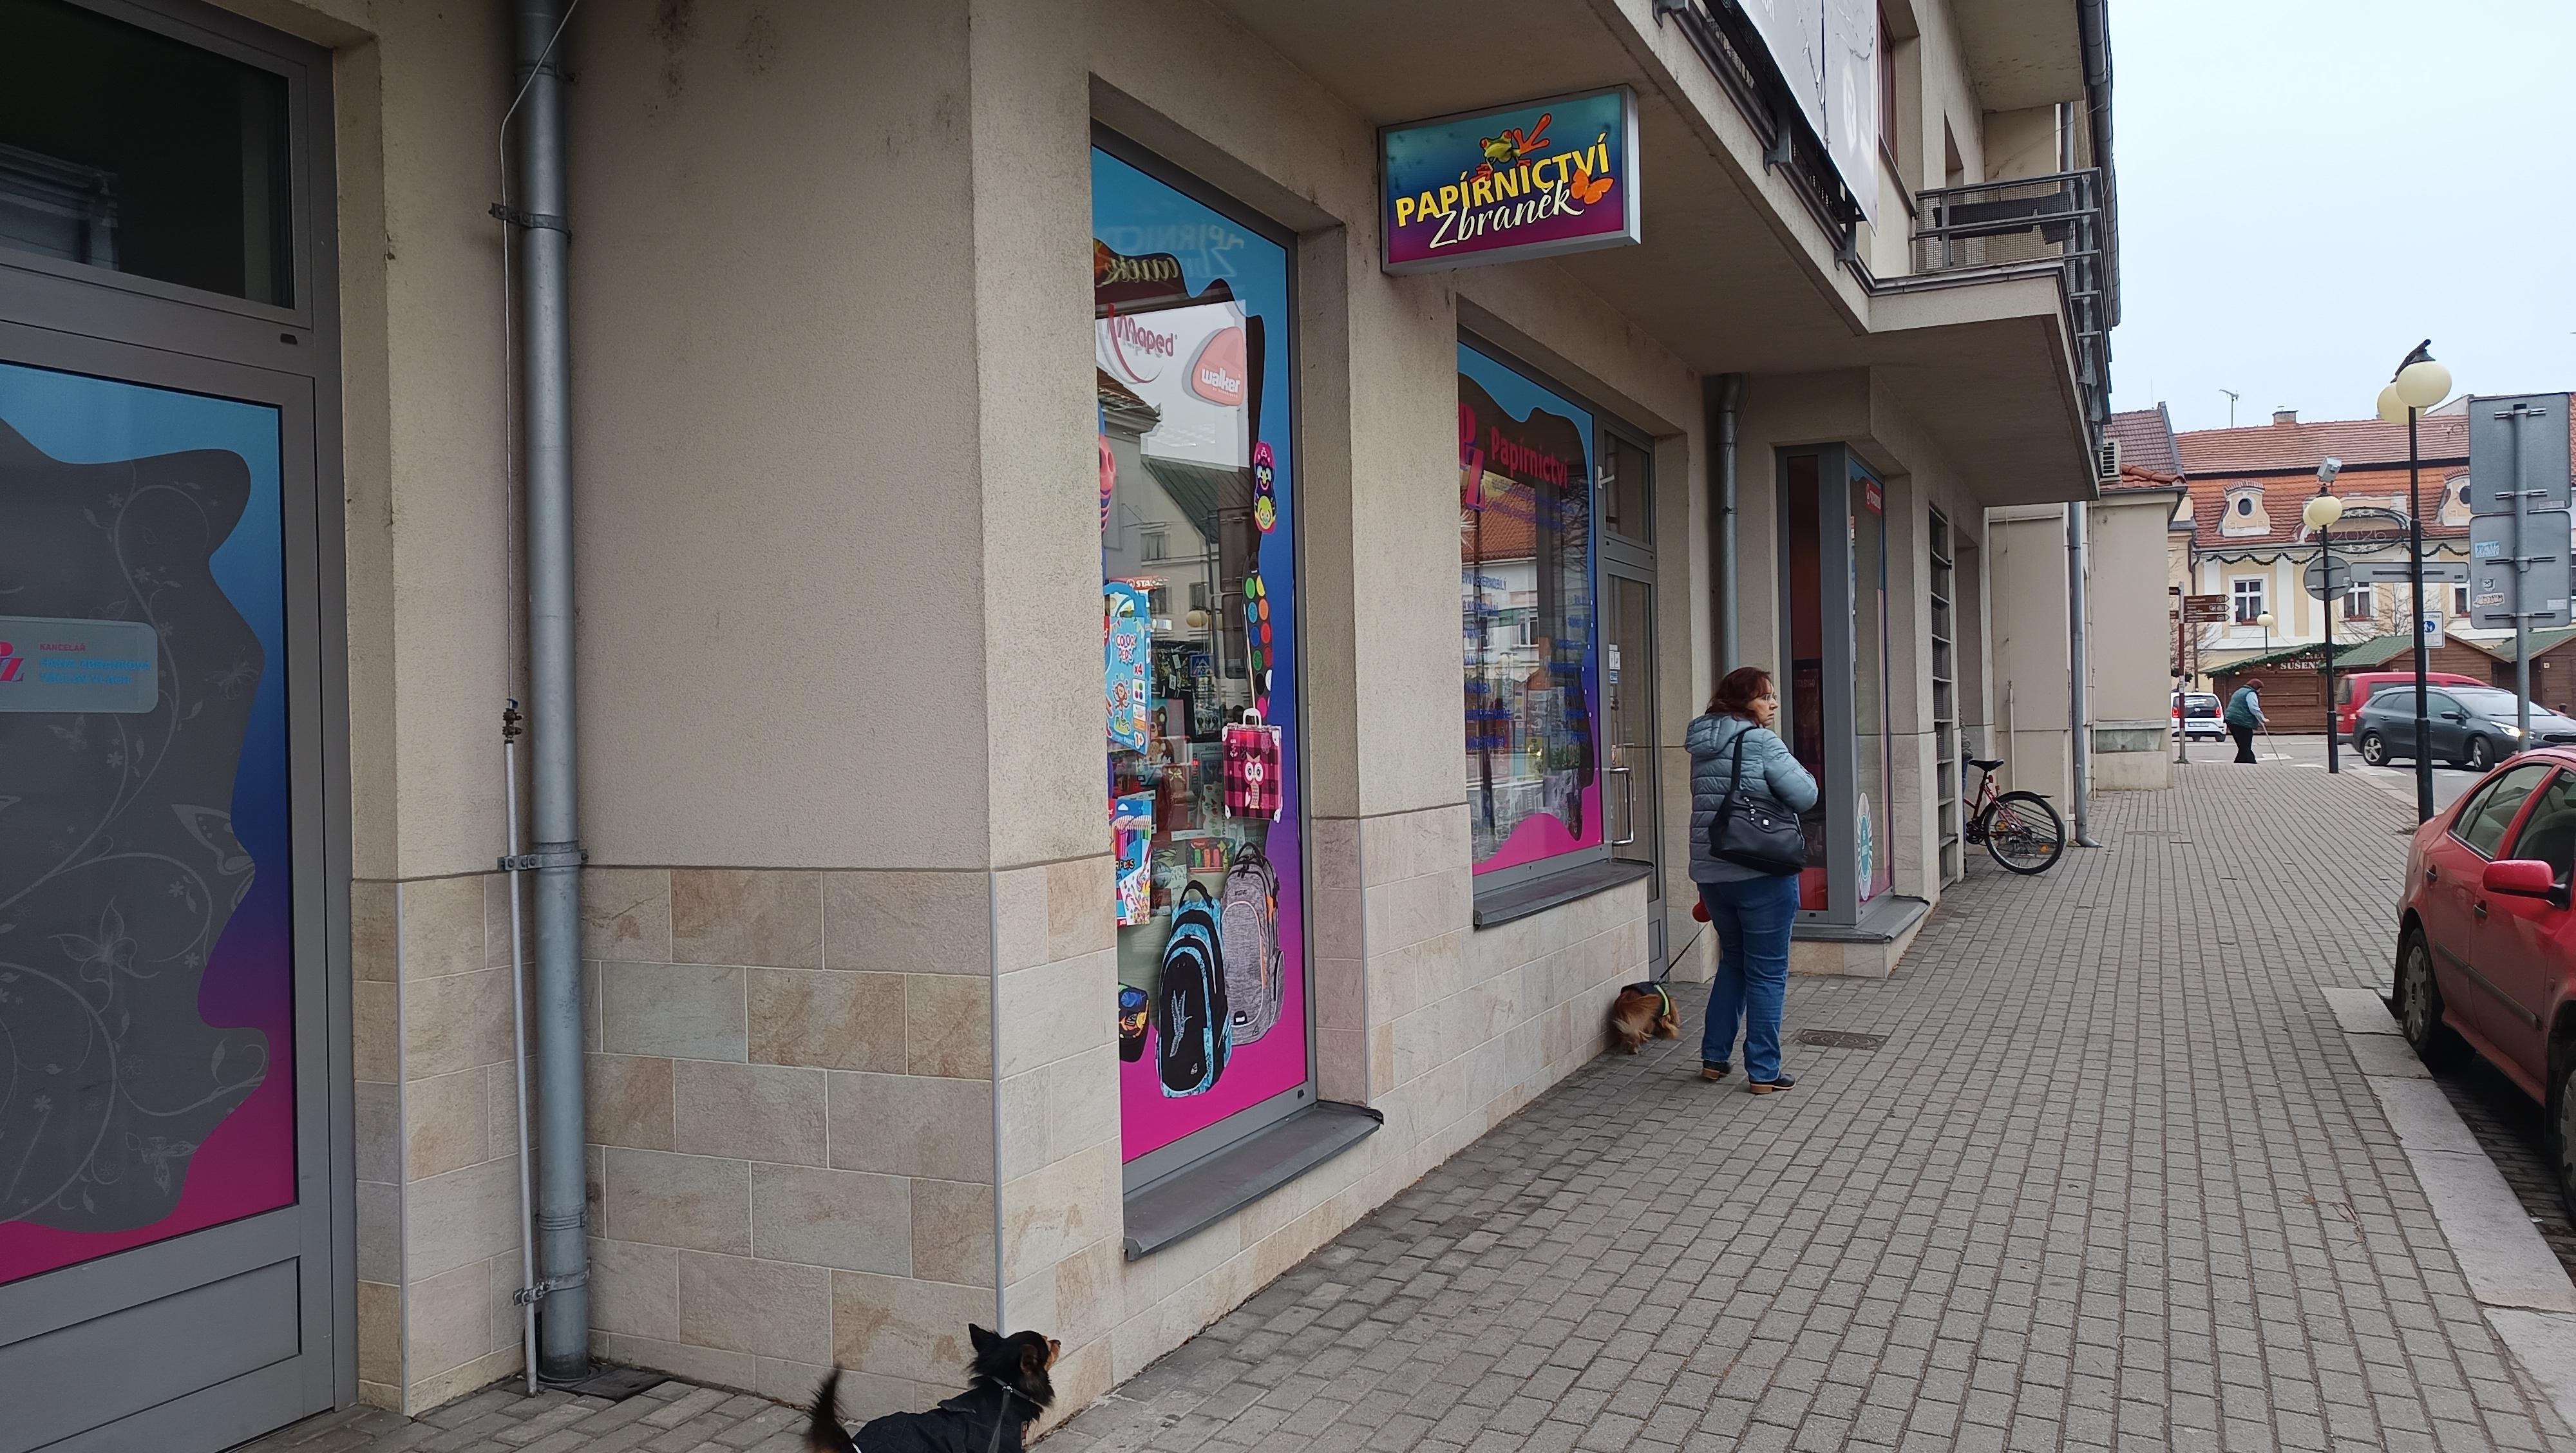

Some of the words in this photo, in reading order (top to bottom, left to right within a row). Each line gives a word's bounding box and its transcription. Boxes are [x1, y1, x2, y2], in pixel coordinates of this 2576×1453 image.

[1395, 132, 1611, 227] PAPÍRNICTVÍ
[1428, 178, 1585, 249] Zbraněk
[1201, 366, 1241, 393] walker
[1490, 426, 1569, 489] Papírnictví
[2331, 526, 2387, 542] 2026
